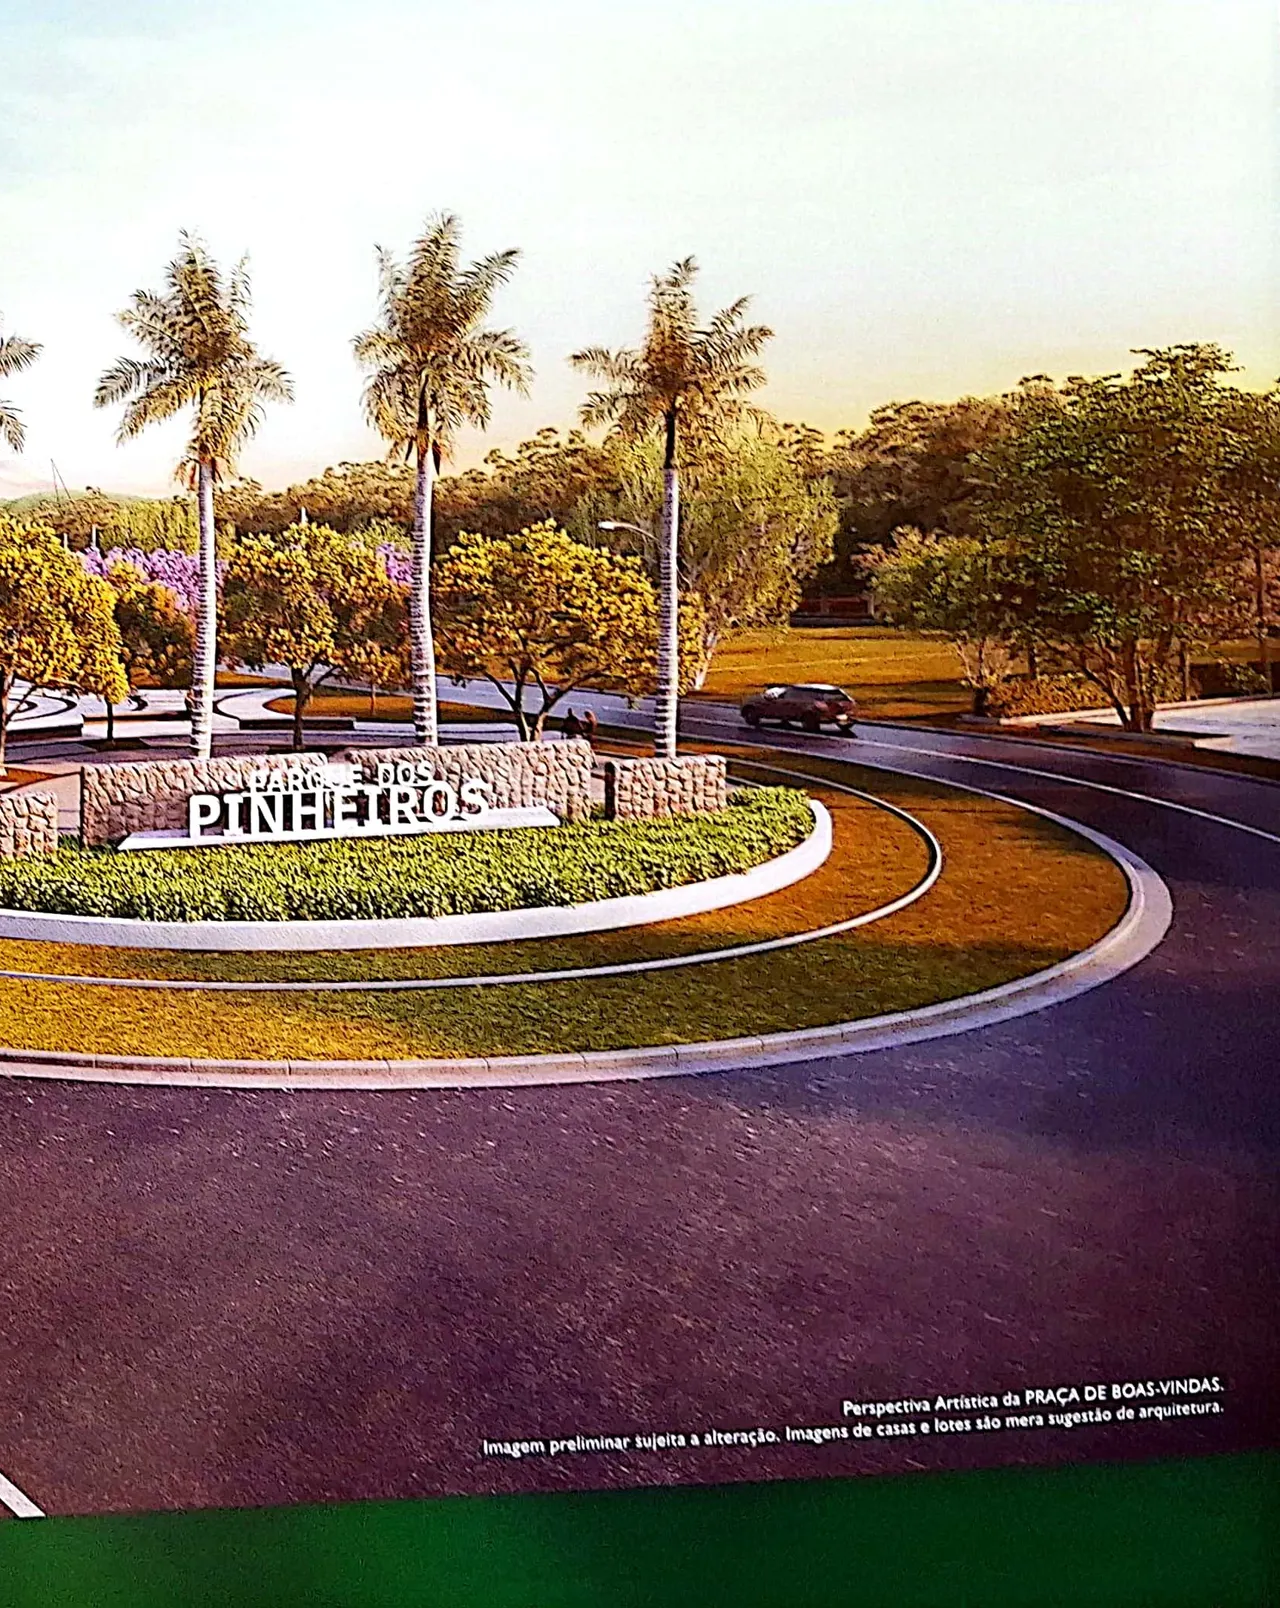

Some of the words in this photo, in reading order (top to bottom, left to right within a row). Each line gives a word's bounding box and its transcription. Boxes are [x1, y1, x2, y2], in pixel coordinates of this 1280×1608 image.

[377, 760, 436, 787] DOS
[189, 778, 492, 838] PINHEIROS
[843, 1398, 931, 1418] Perspectiva
[934, 1394, 999, 1411] Artística
[1002, 1391, 1021, 1407] da
[1024, 1387, 1080, 1407] PRAÇA
[1084, 1384, 1107, 1402] DE
[1111, 1376, 1224, 1400] BOAS-VINDAS.
[483, 1439, 545, 1458] Imagem
[549, 1435, 631, 1456] preliminar
[635, 1432, 686, 1452] sujeita
[704, 1427, 781, 1447] alteração.
[785, 1425, 849, 1444] Imagens
[852, 1422, 872, 1438] de
[876, 1421, 917, 1437] casas
[934, 1417, 972, 1433] lotes
[975, 1415, 1002, 1430] são
[1005, 1414, 1045, 1429] mera
[1048, 1408, 1112, 1428] sugestão
[1116, 1405, 1135, 1421] de
[1138, 1401, 1224, 1421] arquitetura.
